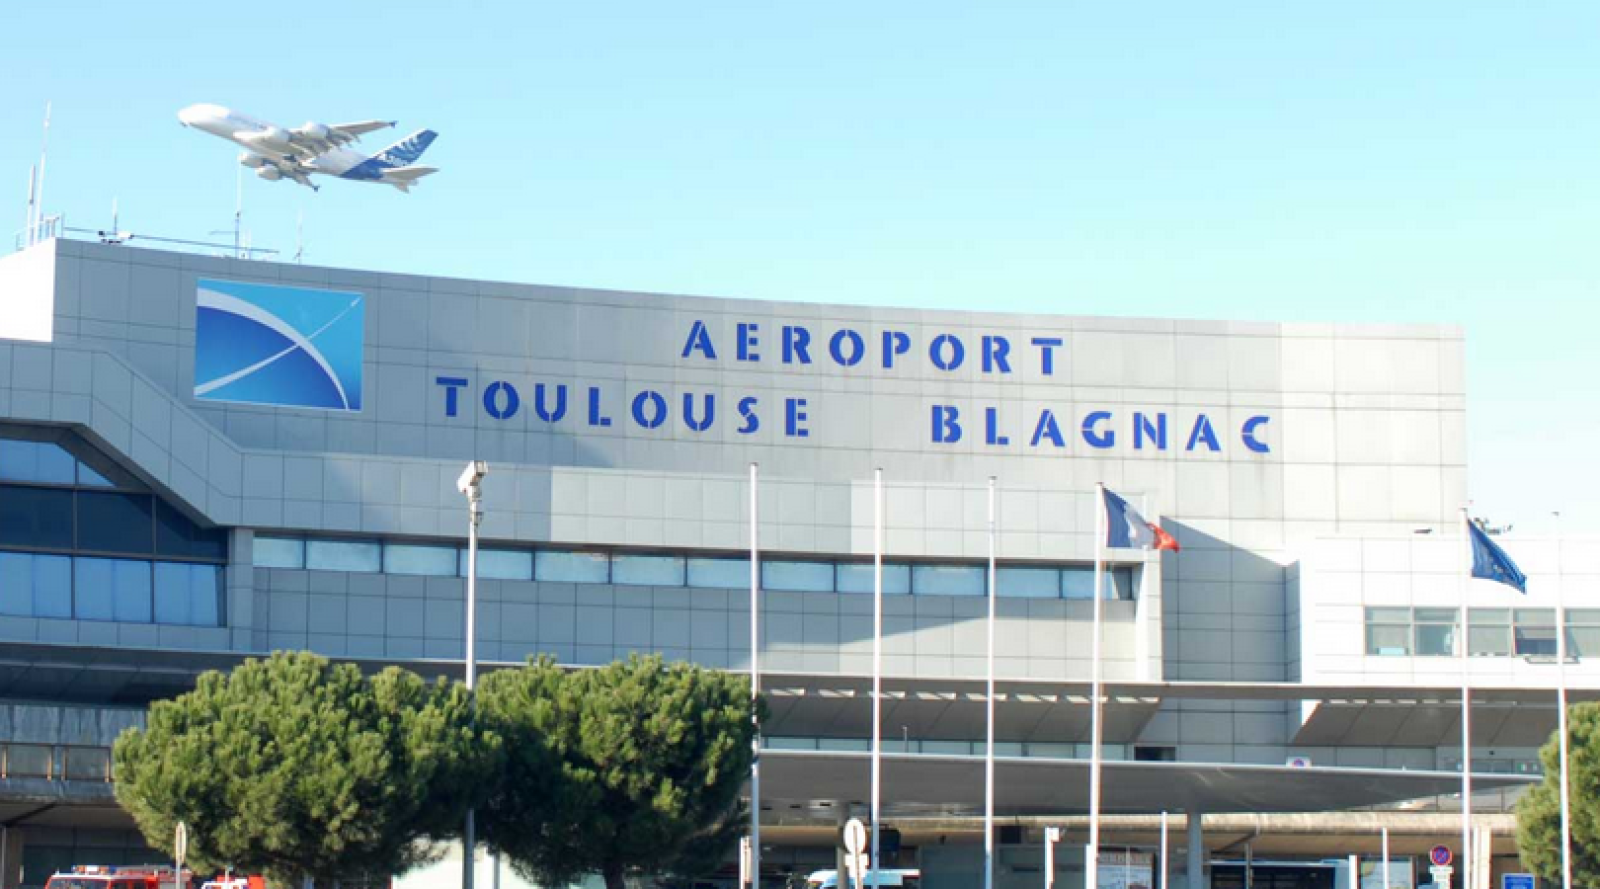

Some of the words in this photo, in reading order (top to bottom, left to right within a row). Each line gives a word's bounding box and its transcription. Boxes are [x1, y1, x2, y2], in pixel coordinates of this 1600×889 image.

[682, 319, 1064, 375] AEROPORT
[435, 375, 810, 437] TOULOUSE
[932, 404, 1270, 453] BLAGNAC
